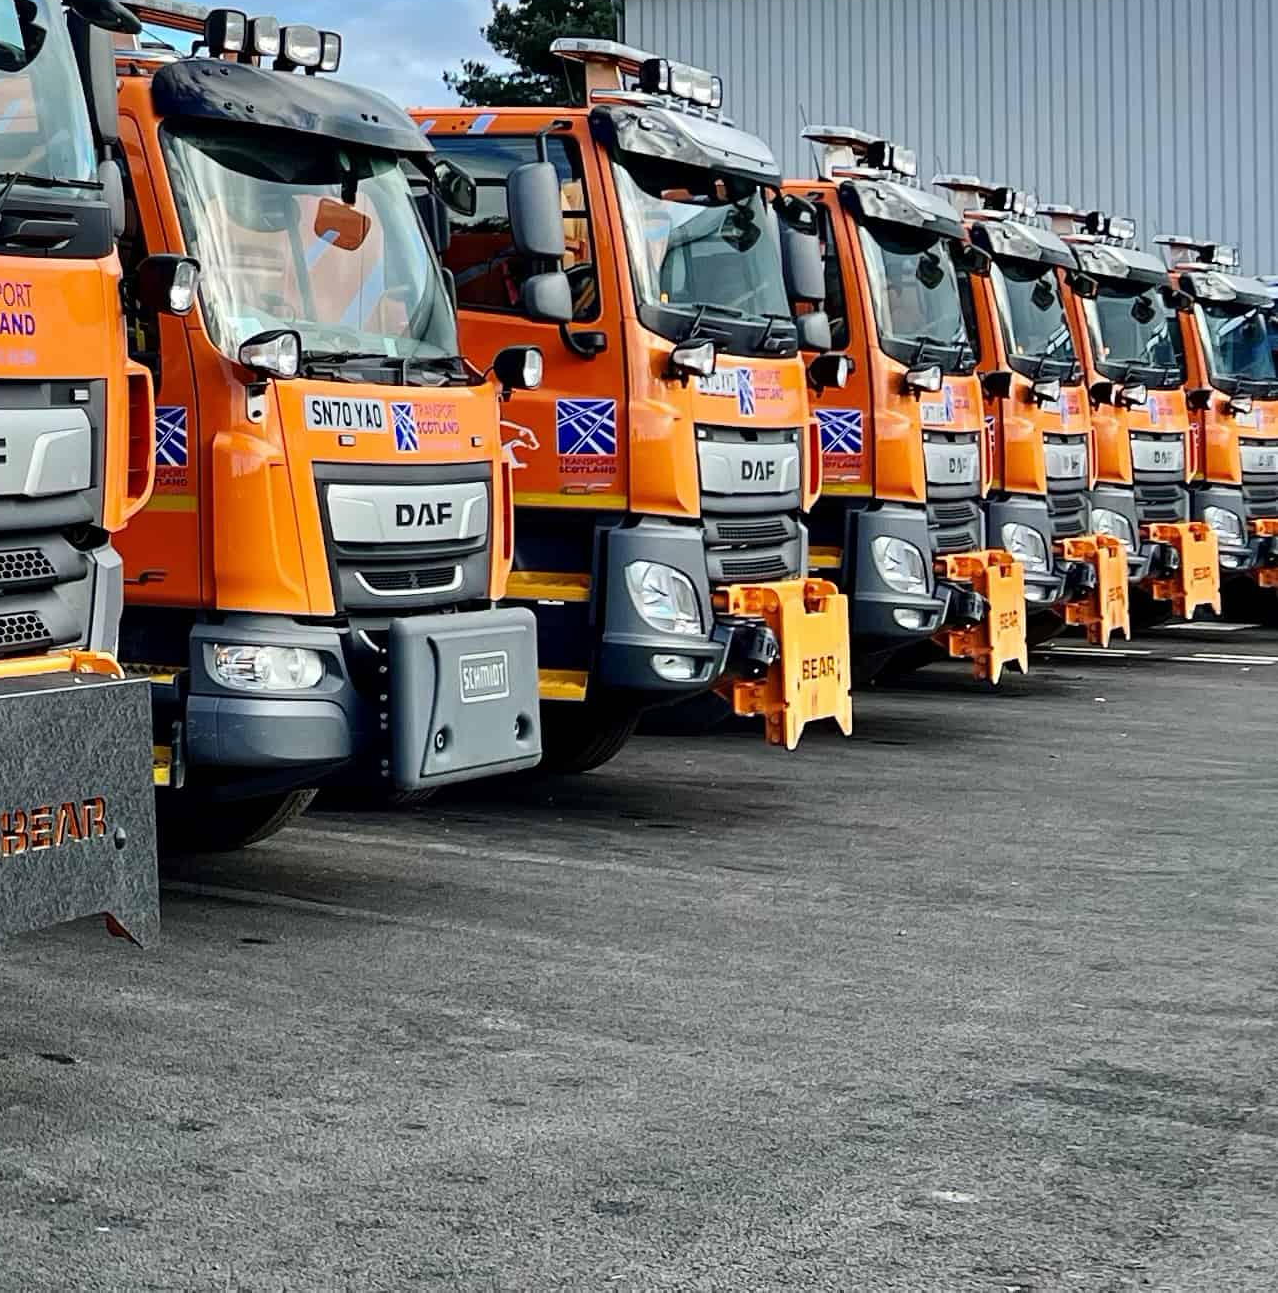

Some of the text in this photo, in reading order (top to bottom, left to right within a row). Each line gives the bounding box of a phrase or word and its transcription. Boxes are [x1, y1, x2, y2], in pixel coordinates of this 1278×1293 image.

[311, 400, 352, 426] SN70
[416, 421, 459, 434] SCOTLAND
[559, 466, 616, 474] SCOTLAND
[741, 460, 774, 481] DAF
[396, 502, 452, 526] DAF
[463, 663, 504, 690] SCHMIDT
[802, 655, 835, 680] BEAR
[0, 794, 107, 857] BEAR
